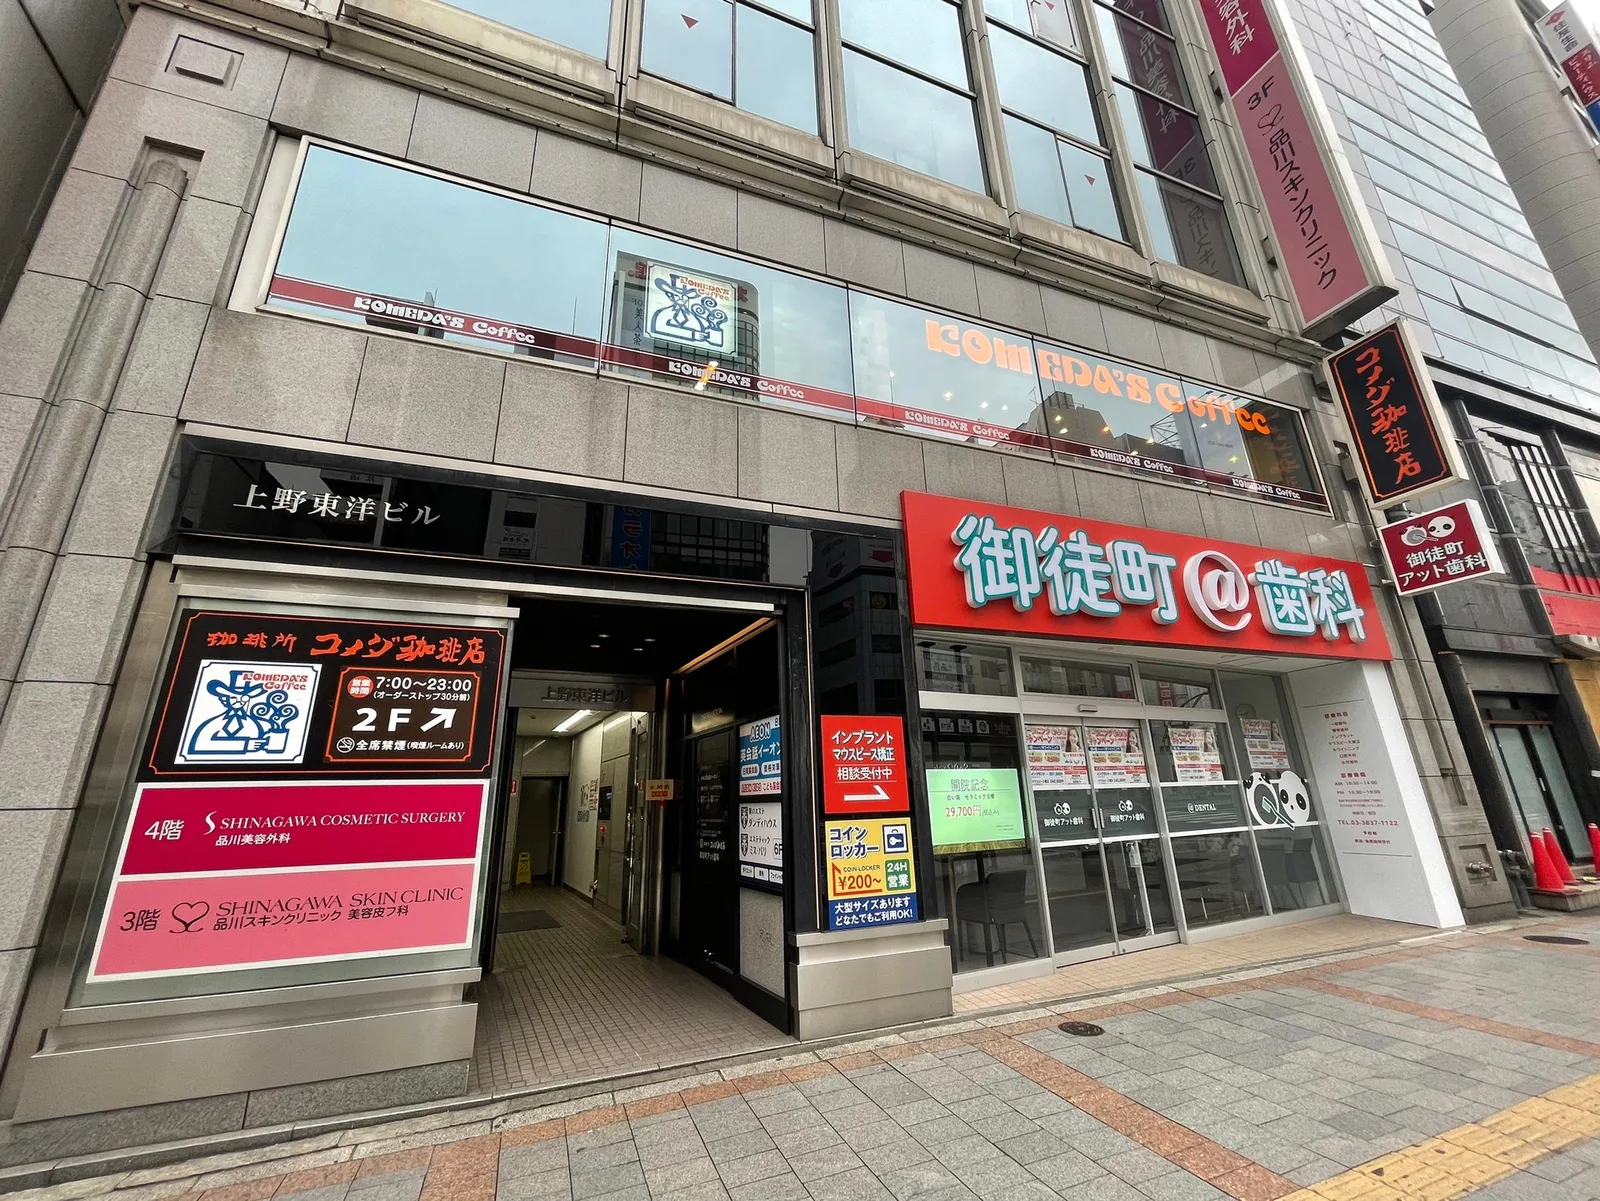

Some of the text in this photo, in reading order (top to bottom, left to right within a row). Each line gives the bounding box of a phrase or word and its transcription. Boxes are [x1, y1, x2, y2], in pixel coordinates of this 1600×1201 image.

[1247, 75, 1275, 110] 3F
[1268, 127, 1338, 290] 品川スキンクリニック
[472, 321, 536, 344] Coffee
[756, 380, 805, 399] Coffee
[1355, 346, 1423, 485] コメダ珈琲店
[973, 424, 1010, 441] Coffee
[1144, 459, 1174, 473] Coffee
[233, 484, 441, 526] 上野東洋ビル
[1405, 540, 1465, 568] 御徒町
[951, 513, 1367, 643] 御徒町@歯科
[1398, 551, 1487, 587] アット歯科
[310, 633, 487, 666] コメダ珈琲店
[264, 680, 307, 691] Coffee
[350, 687, 371, 696] 時間
[541, 685, 630, 703] 上野東洋ビル
[750, 721, 771, 743] AEON
[831, 730, 894, 745] インプラント
[832, 747, 896, 762] マウスピース矯正
[836, 766, 893, 781] 相談受付中
[1194, 803, 1217, 812] DENTAL
[144, 818, 185, 841] 4階
[219, 810, 466, 830] SHINAGAWA COSMETIC SURGERY
[215, 832, 291, 847] 品川美容外科
[829, 826, 868, 842] コイン
[830, 843, 880, 860] ロッカー
[886, 861, 908, 872] 24H
[887, 874, 909, 890] 営業
[215, 886, 464, 917] SHINAGAWA SKIN CLINIC
[834, 895, 911, 915] 大型サイズあります
[119, 908, 161, 932] 3階
[212, 904, 409, 931] 品川スキンクリニック 美容皮フ科
